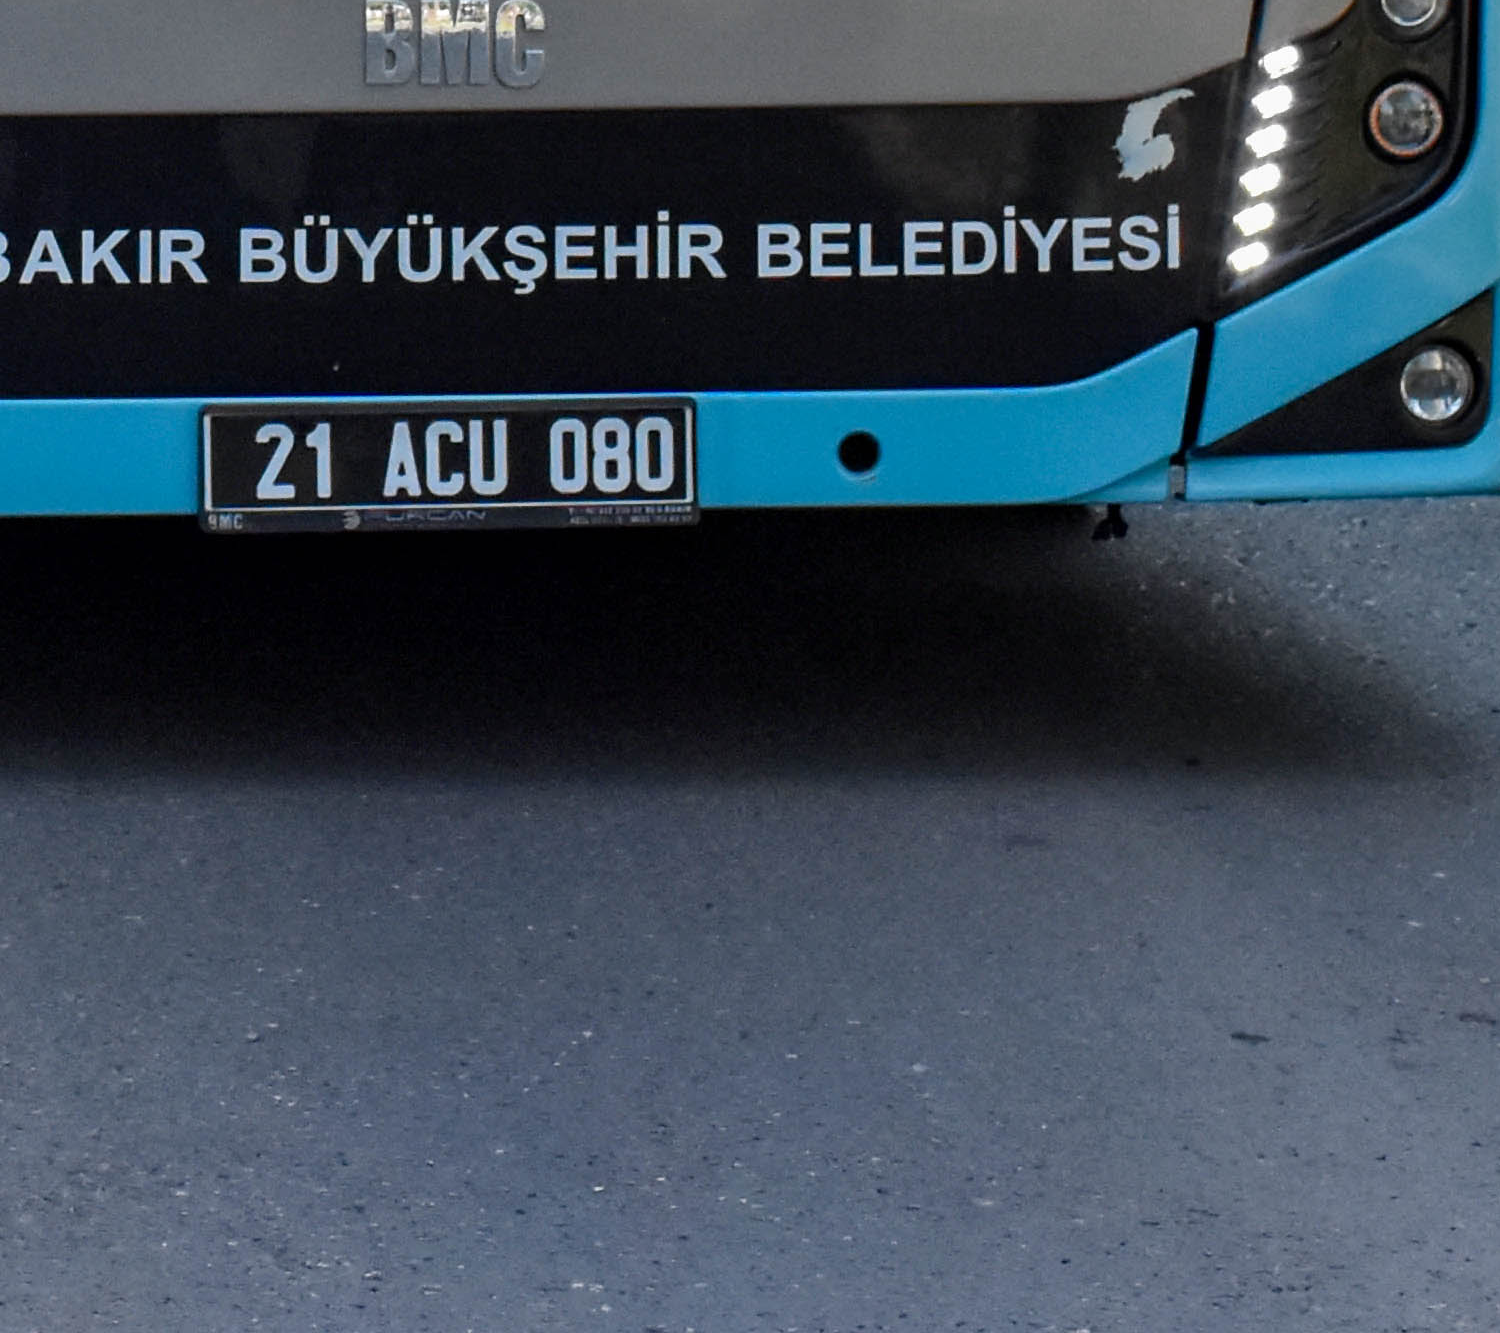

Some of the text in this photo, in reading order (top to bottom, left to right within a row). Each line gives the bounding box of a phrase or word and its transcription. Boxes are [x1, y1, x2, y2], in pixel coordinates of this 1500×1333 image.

[239, 210, 726, 295] BÜYÜKŞEHİR
[756, 204, 1180, 279] BELEDİYESİ
[255, 416, 674, 500] 21 ACU 080
